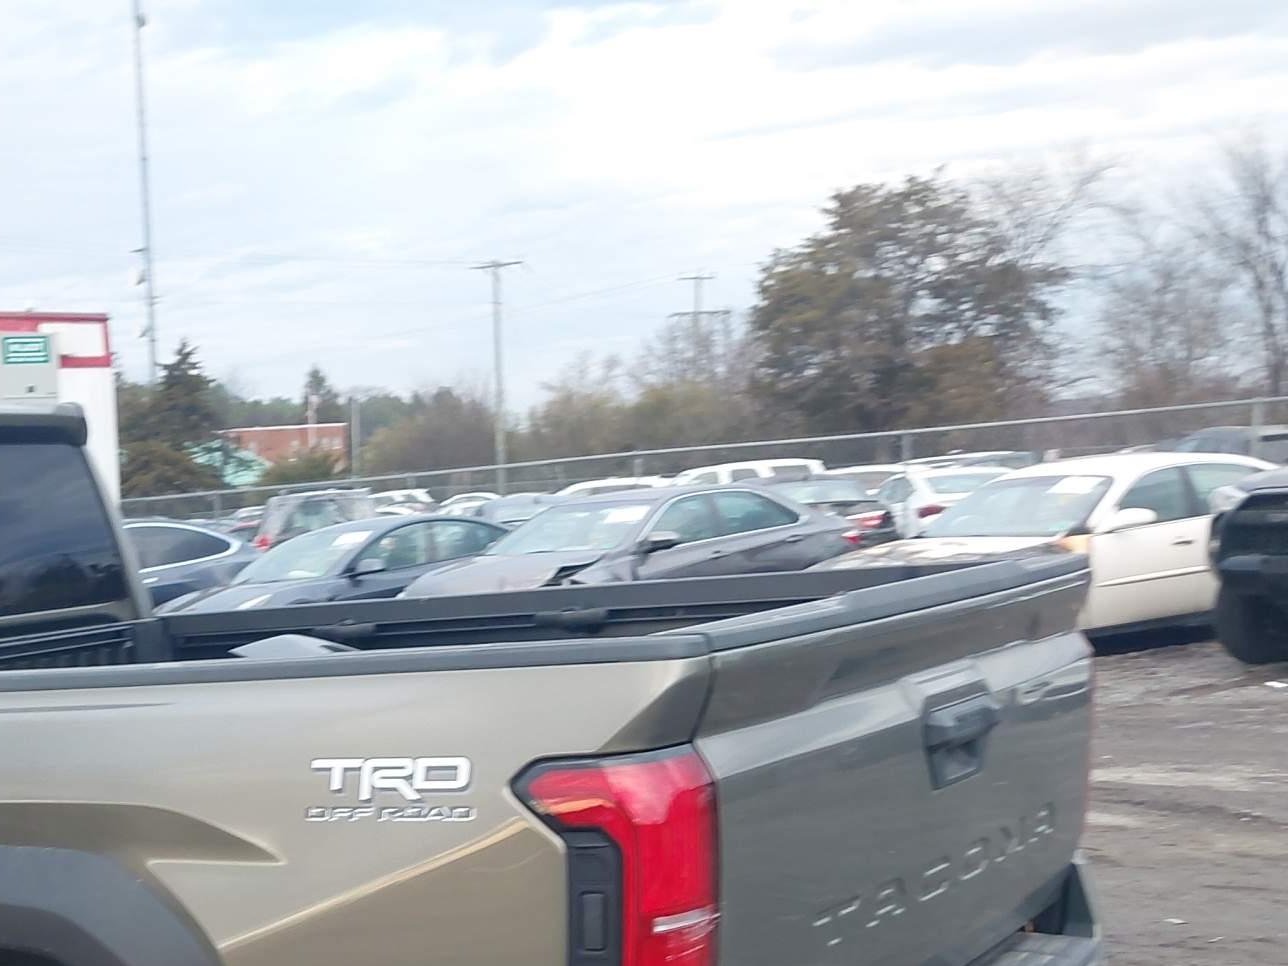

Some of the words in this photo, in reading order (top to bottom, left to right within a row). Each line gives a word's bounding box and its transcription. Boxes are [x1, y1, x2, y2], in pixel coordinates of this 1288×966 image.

[310, 756, 473, 801] TRD
[304, 805, 376, 823] OFF
[376, 805, 479, 823] ROAD
[812, 801, 1057, 948] TACOMA
